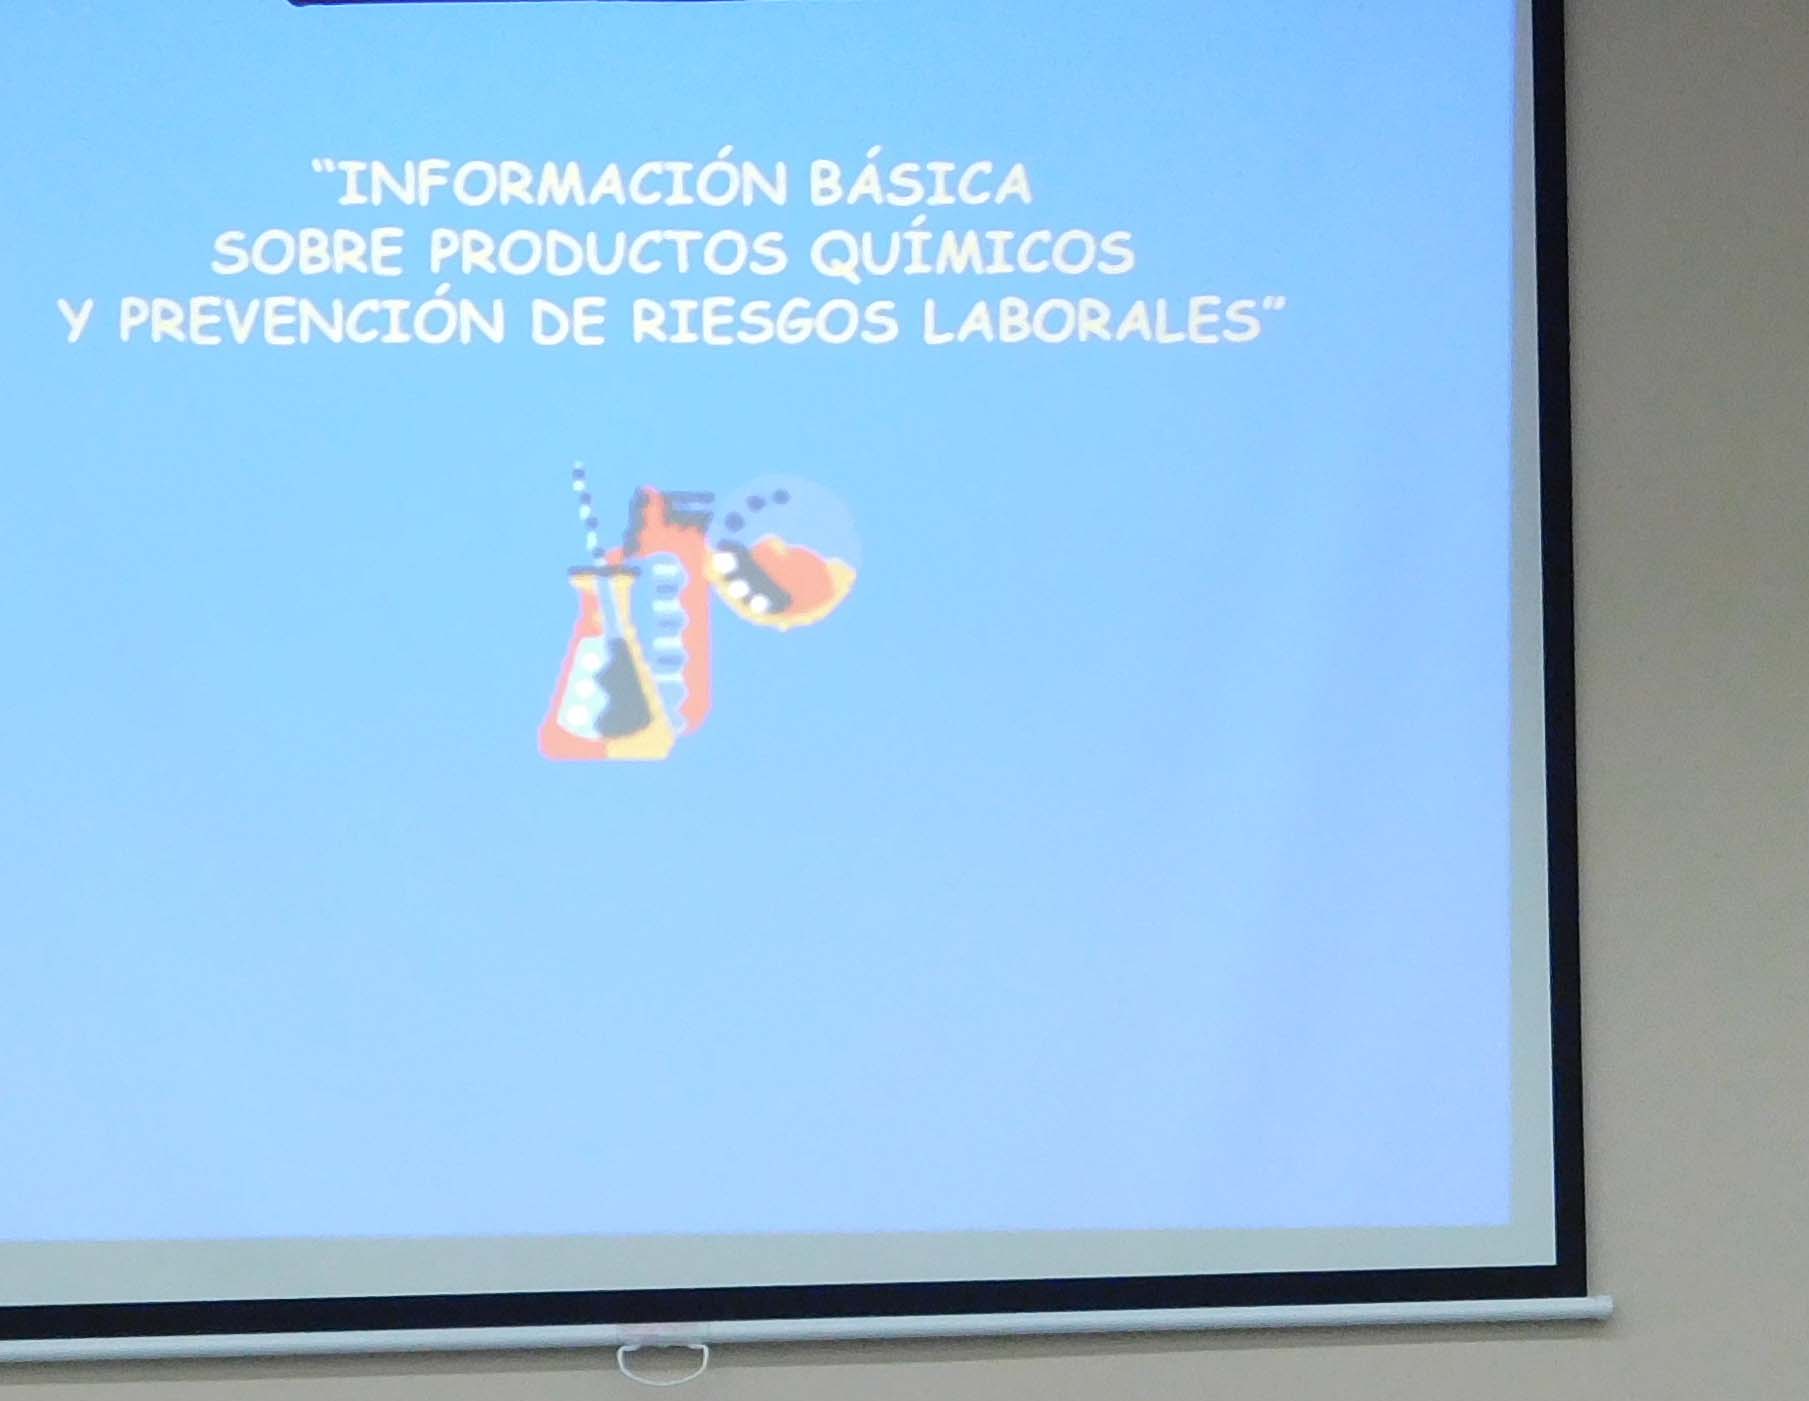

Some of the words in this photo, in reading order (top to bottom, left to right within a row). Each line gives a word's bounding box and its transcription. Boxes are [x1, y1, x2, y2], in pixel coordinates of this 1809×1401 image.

[811, 145, 1032, 206] BÁSICA
[212, 227, 403, 276] SOBRE
[431, 228, 787, 276] PRODUCTOS
[811, 215, 1135, 284] QUÍMICOS
[57, 298, 94, 342] Y
[120, 283, 505, 346] PREVENCIÓN
[532, 296, 606, 346] DE
[633, 296, 899, 345] RIESGOS
